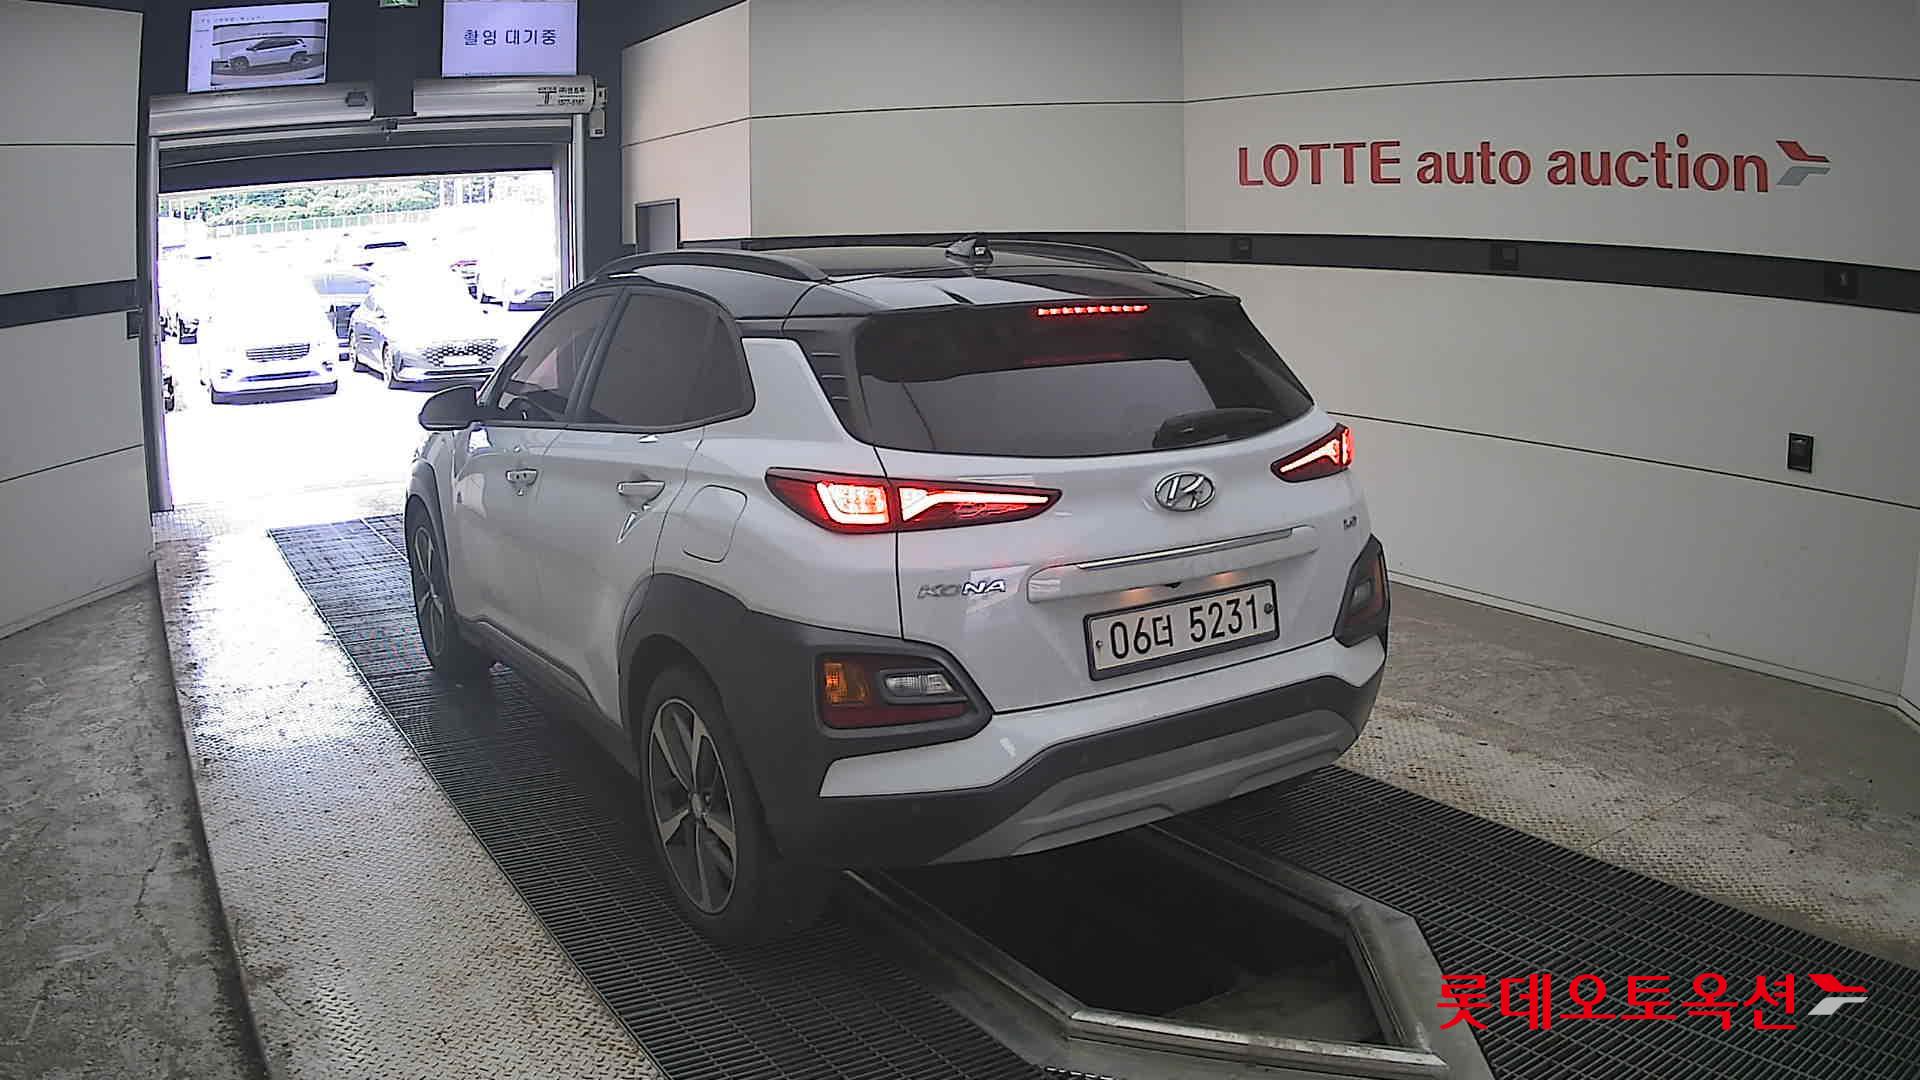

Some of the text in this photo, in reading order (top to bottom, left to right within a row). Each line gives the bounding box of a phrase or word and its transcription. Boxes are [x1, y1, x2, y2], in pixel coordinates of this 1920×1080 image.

[505, 29, 556, 46] 대기중
[1238, 133, 1768, 193] LOTTE auto auction
[917, 579, 1006, 599] KONA
[1109, 594, 1257, 659] 06더 5231
